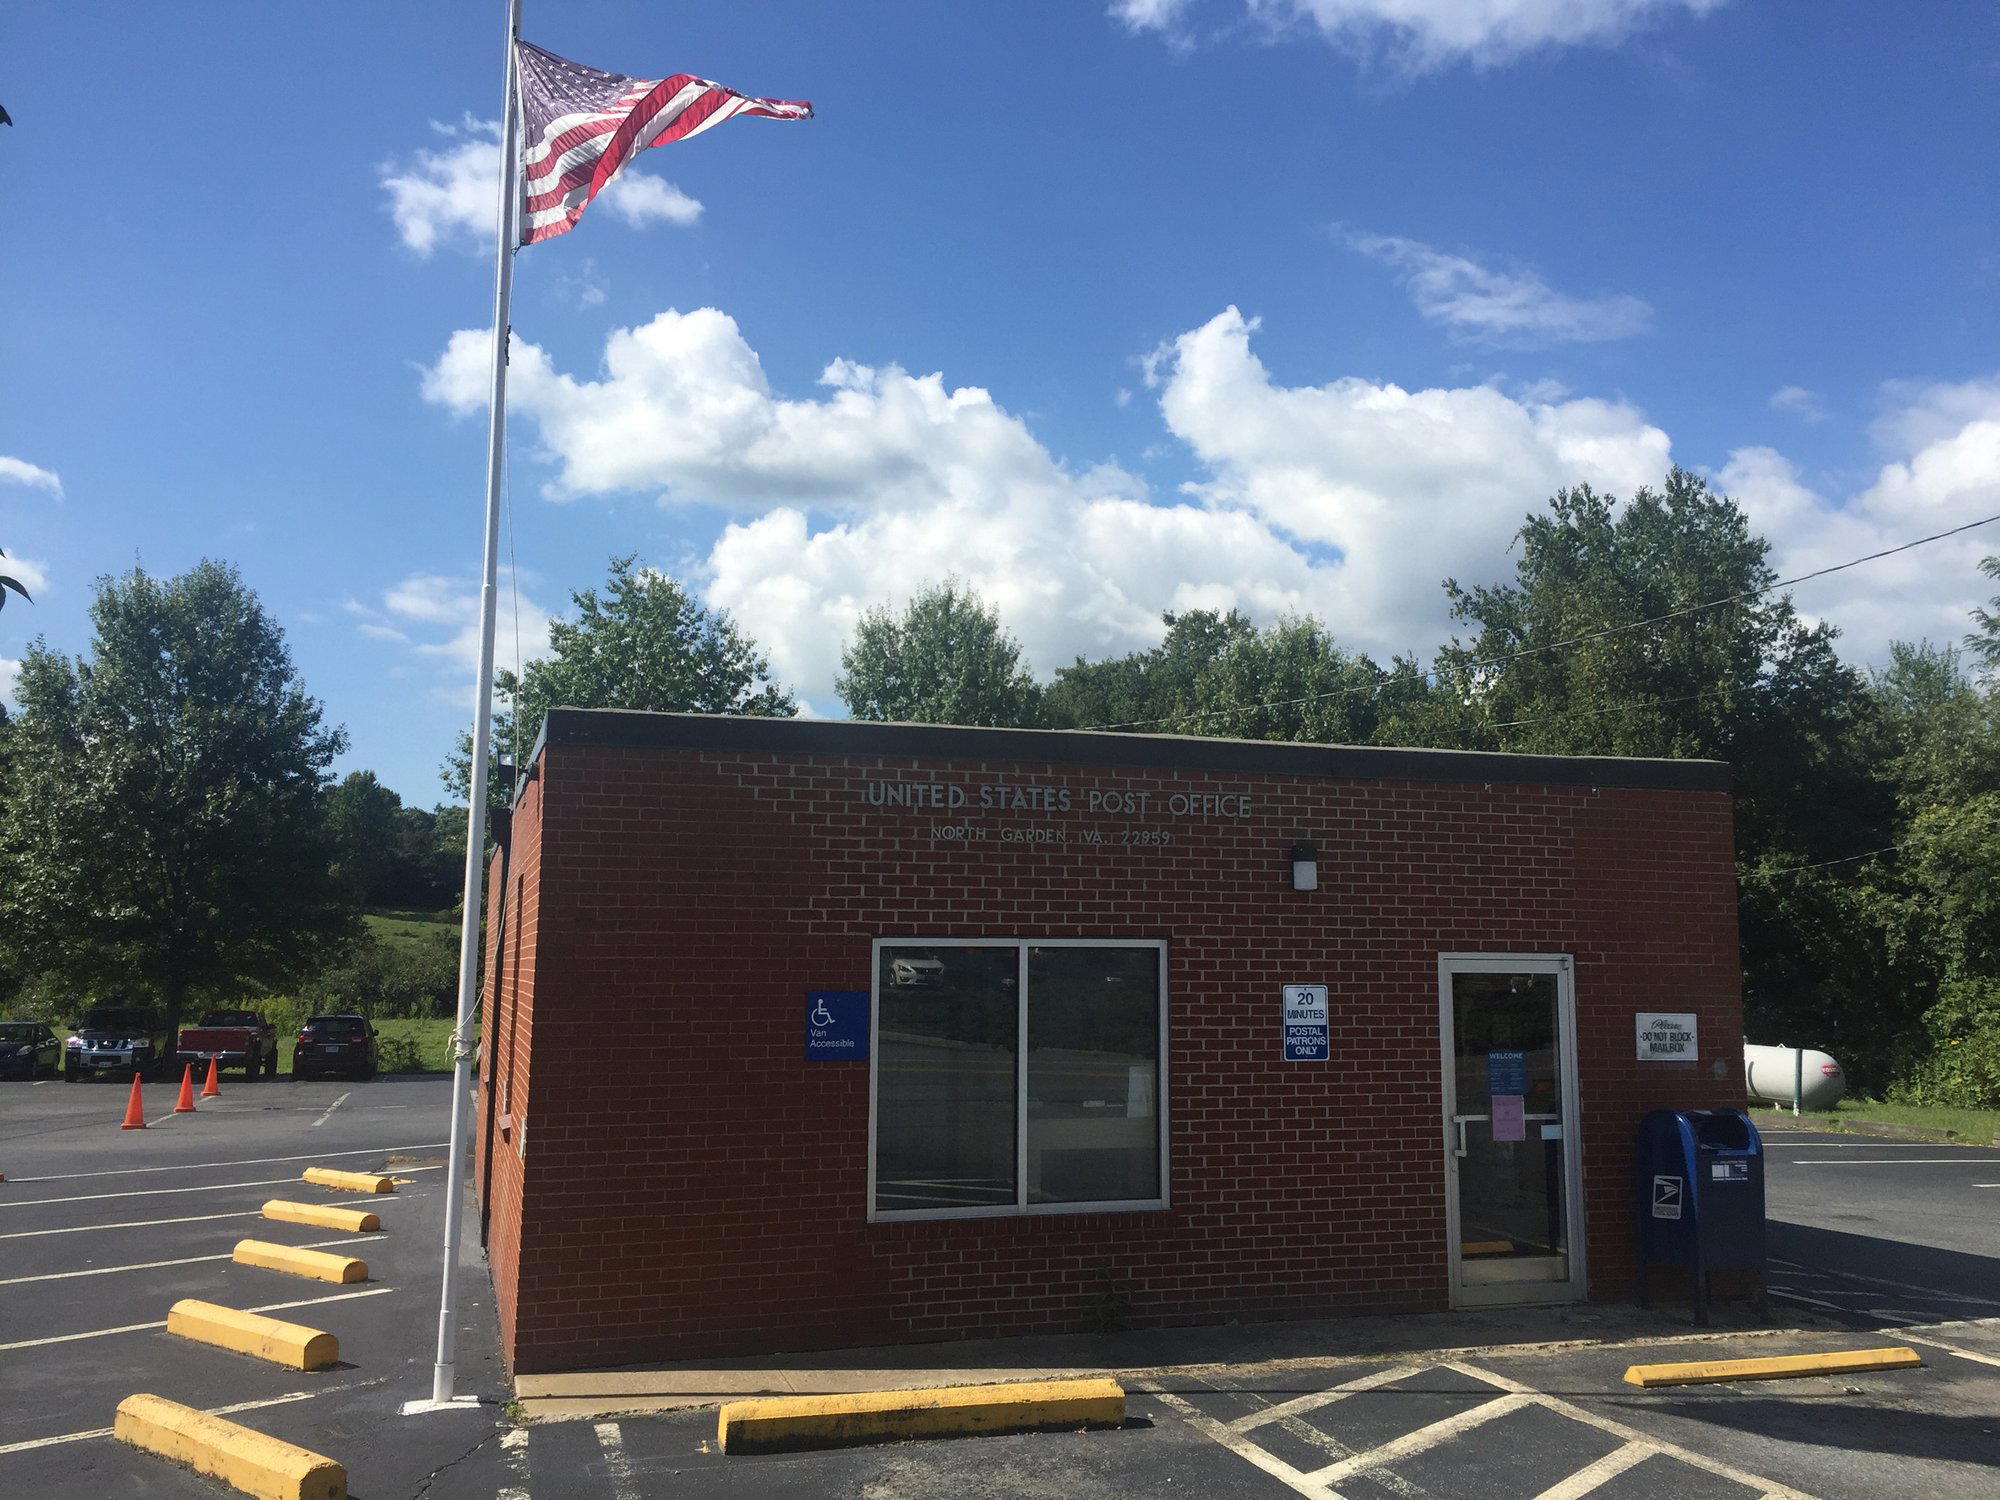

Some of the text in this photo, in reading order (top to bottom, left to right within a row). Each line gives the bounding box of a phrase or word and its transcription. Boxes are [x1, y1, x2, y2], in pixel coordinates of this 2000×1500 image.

[868, 782, 1252, 818] UNITED STATES POST OFFICE
[931, 825, 987, 841] NORTH
[1082, 829, 1108, 844] VA.
[1297, 992, 1314, 1006] 20
[1287, 1009, 1325, 1020] MINUTES
[810, 1028, 827, 1037] Van
[1289, 1027, 1323, 1036] POSTAL
[1286, 1036, 1327, 1046] PATRONS
[1654, 1032, 1667, 1041] NOT
[810, 1039, 855, 1048] Accessible
[1650, 1043, 1685, 1052] MAILBOX
[1295, 1046, 1318, 1055] ONLY
[1489, 1052, 1523, 1060] WELCOME
